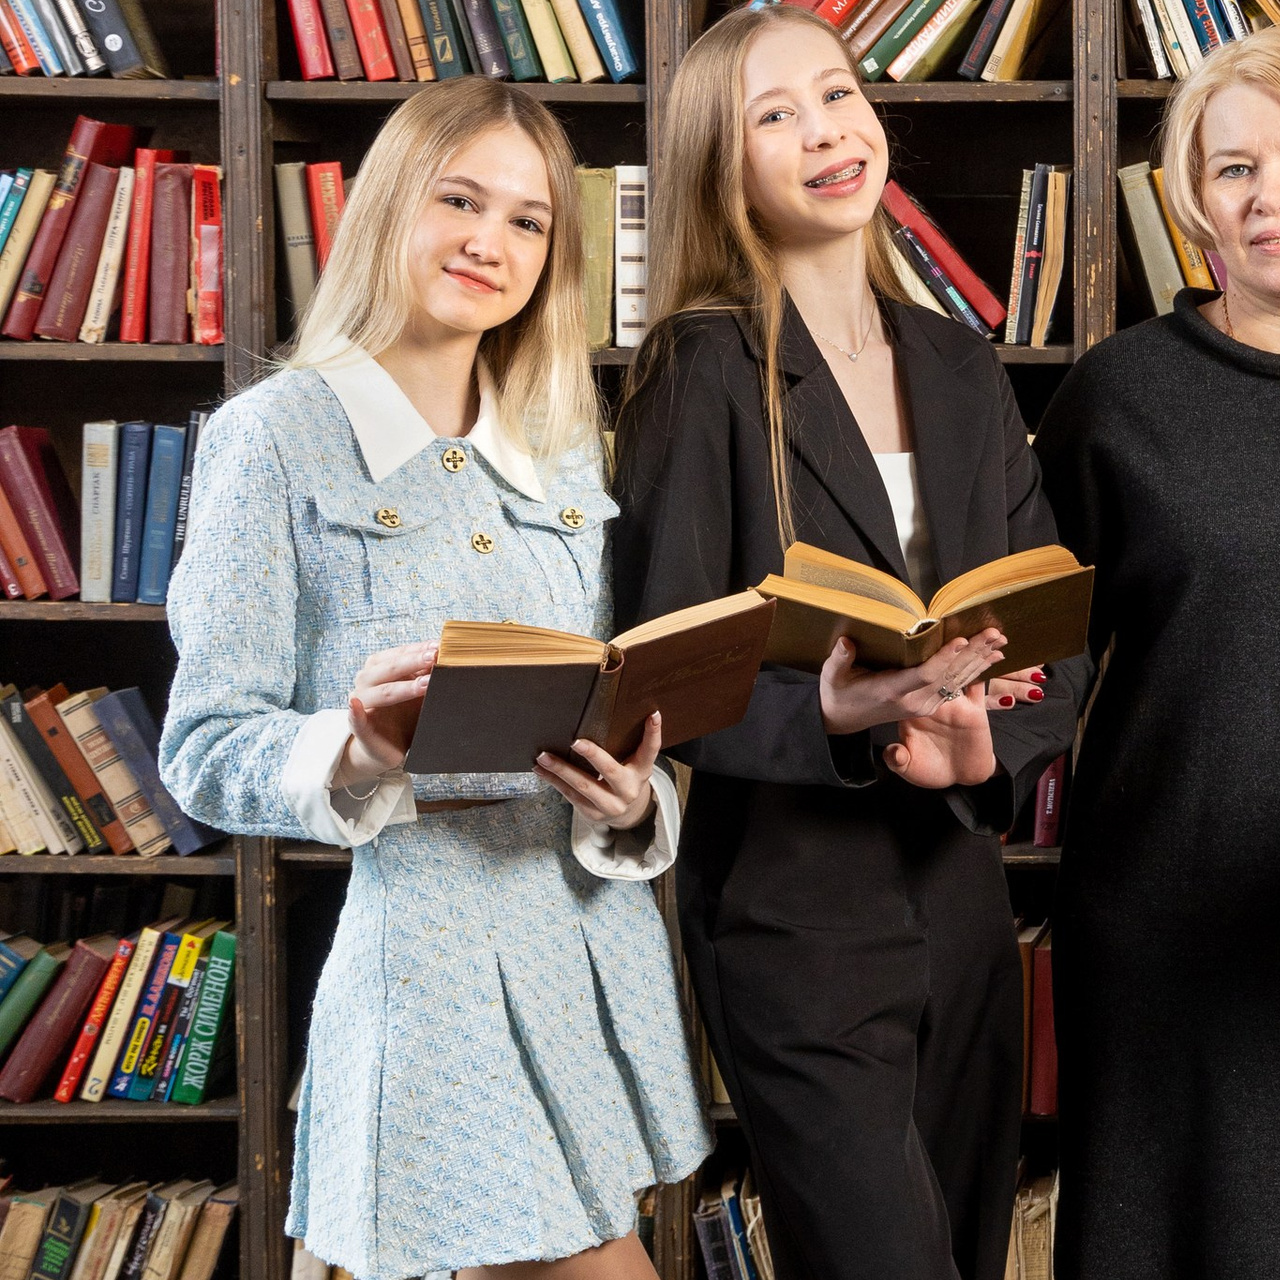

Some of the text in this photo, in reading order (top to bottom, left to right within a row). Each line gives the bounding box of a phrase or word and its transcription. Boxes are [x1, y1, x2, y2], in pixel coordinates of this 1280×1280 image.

[593, 11, 623, 72] Физкультура
[92, 472, 100, 514] СПАРТАК
[175, 475, 193, 542] THE UNRULES
[182, 954, 231, 1089] ЖОРЖ СИМЕНОН
